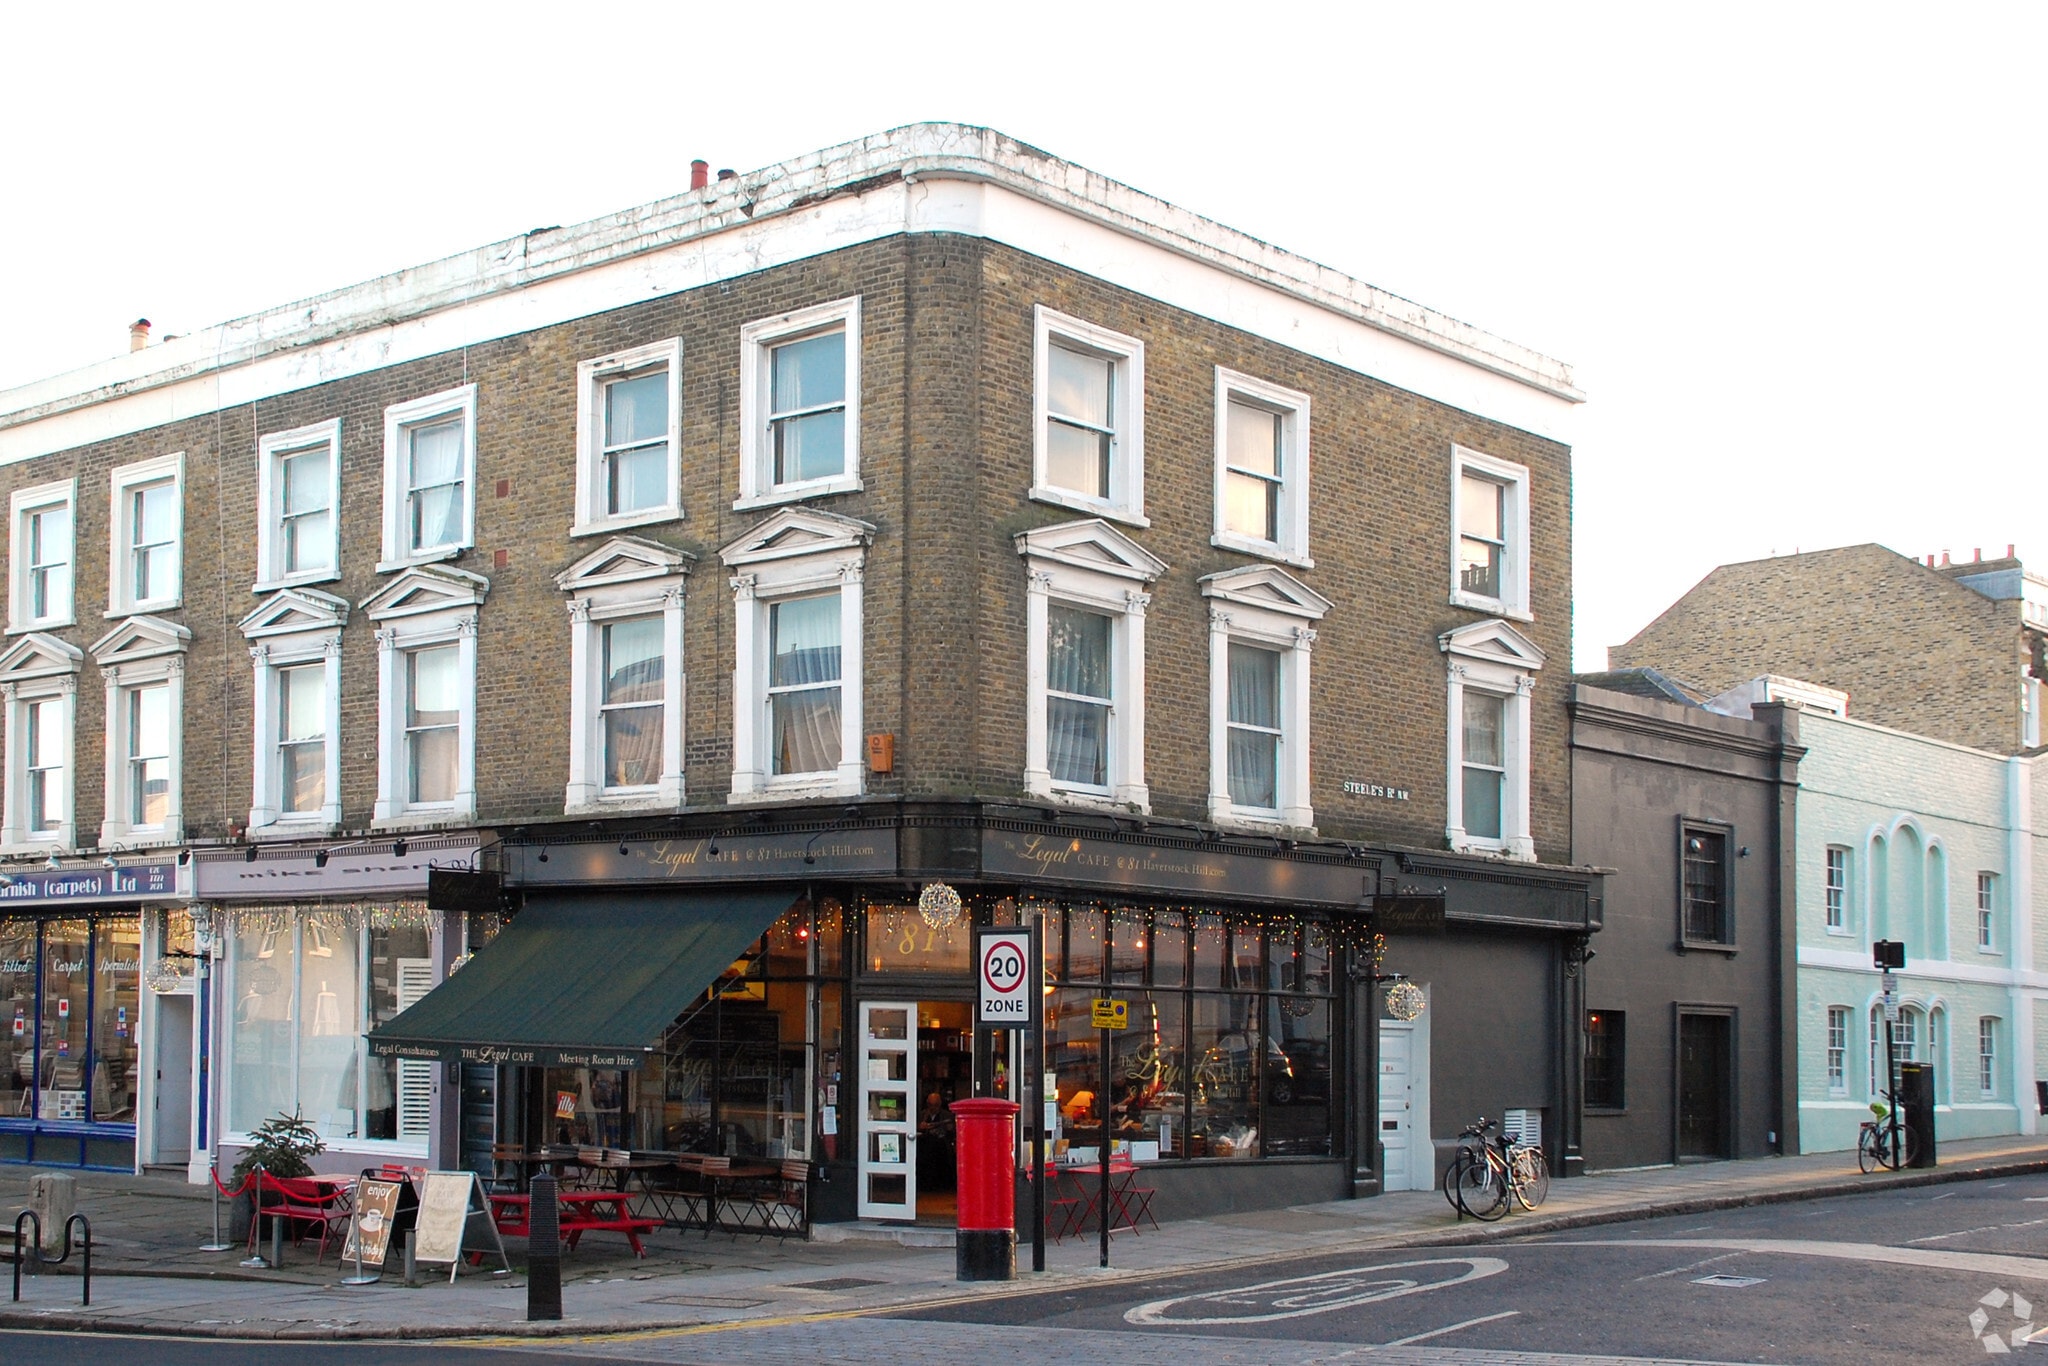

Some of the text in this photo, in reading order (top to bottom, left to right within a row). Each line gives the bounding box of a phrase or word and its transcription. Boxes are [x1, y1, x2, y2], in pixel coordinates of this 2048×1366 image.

[1344, 781, 1384, 797] STEELE'S
[647, 840, 706, 876] Legal
[705, 850, 739, 863] CAFE
[757, 849, 771, 861] 81
[1016, 835, 1076, 876] Legal
[1077, 853, 1110, 867] CAFE
[1117, 857, 1125, 868] @
[1127, 856, 1140, 870] 81
[1143, 859, 1190, 874] Haverstock
[44, 876, 102, 898] (carpets)
[111, 870, 137, 893] Ltd
[899, 923, 936, 955] 81
[53, 958, 83, 978] Carpet
[991, 957, 1019, 977] 20
[986, 1000, 1023, 1012] ZONE
[375, 1043, 394, 1056] Legal
[461, 1046, 535, 1064] THE Legal CAFE
[558, 1053, 635, 1066] Meeting Room Hire
[558, 1096, 575, 1115] illy
